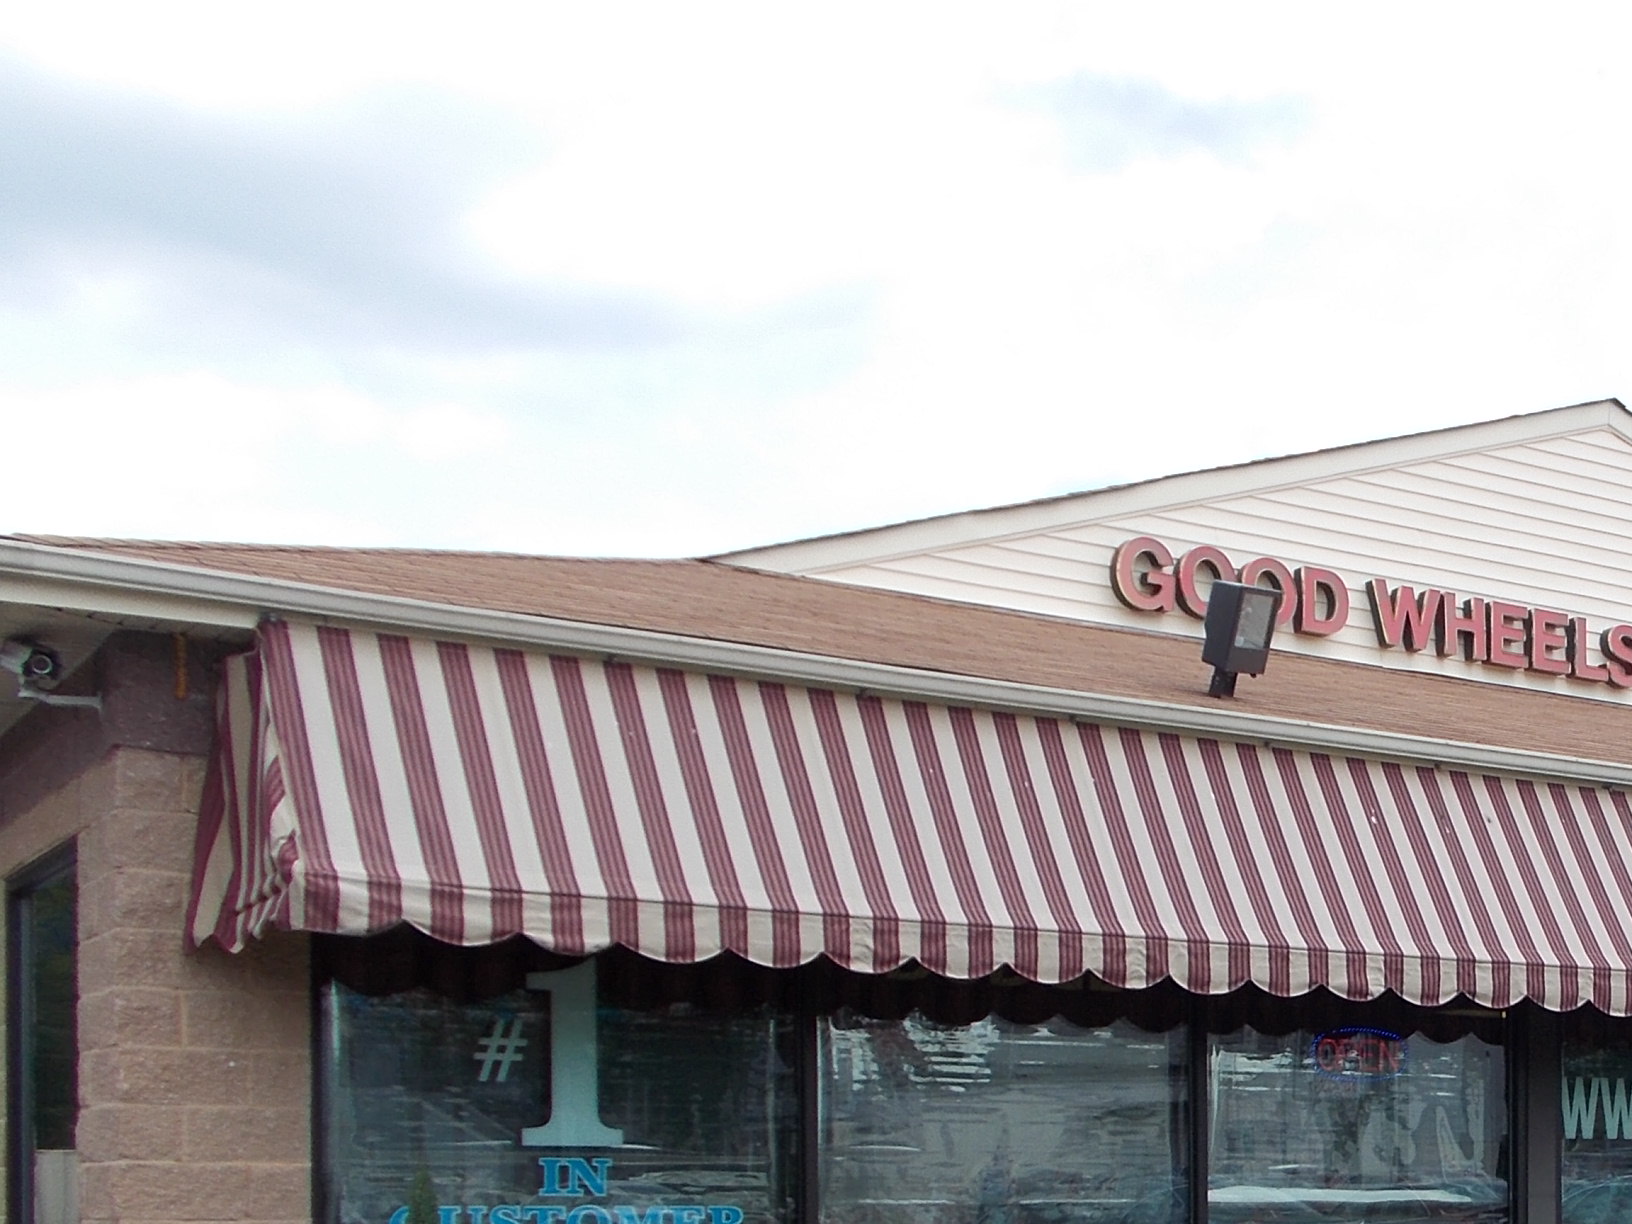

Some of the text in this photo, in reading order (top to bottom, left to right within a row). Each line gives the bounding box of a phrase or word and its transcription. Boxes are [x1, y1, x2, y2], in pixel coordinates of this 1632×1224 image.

[1110, 536, 1350, 637] GOOD
[1318, 1038, 1400, 1072] OPEN
[538, 1157, 612, 1197] IN
